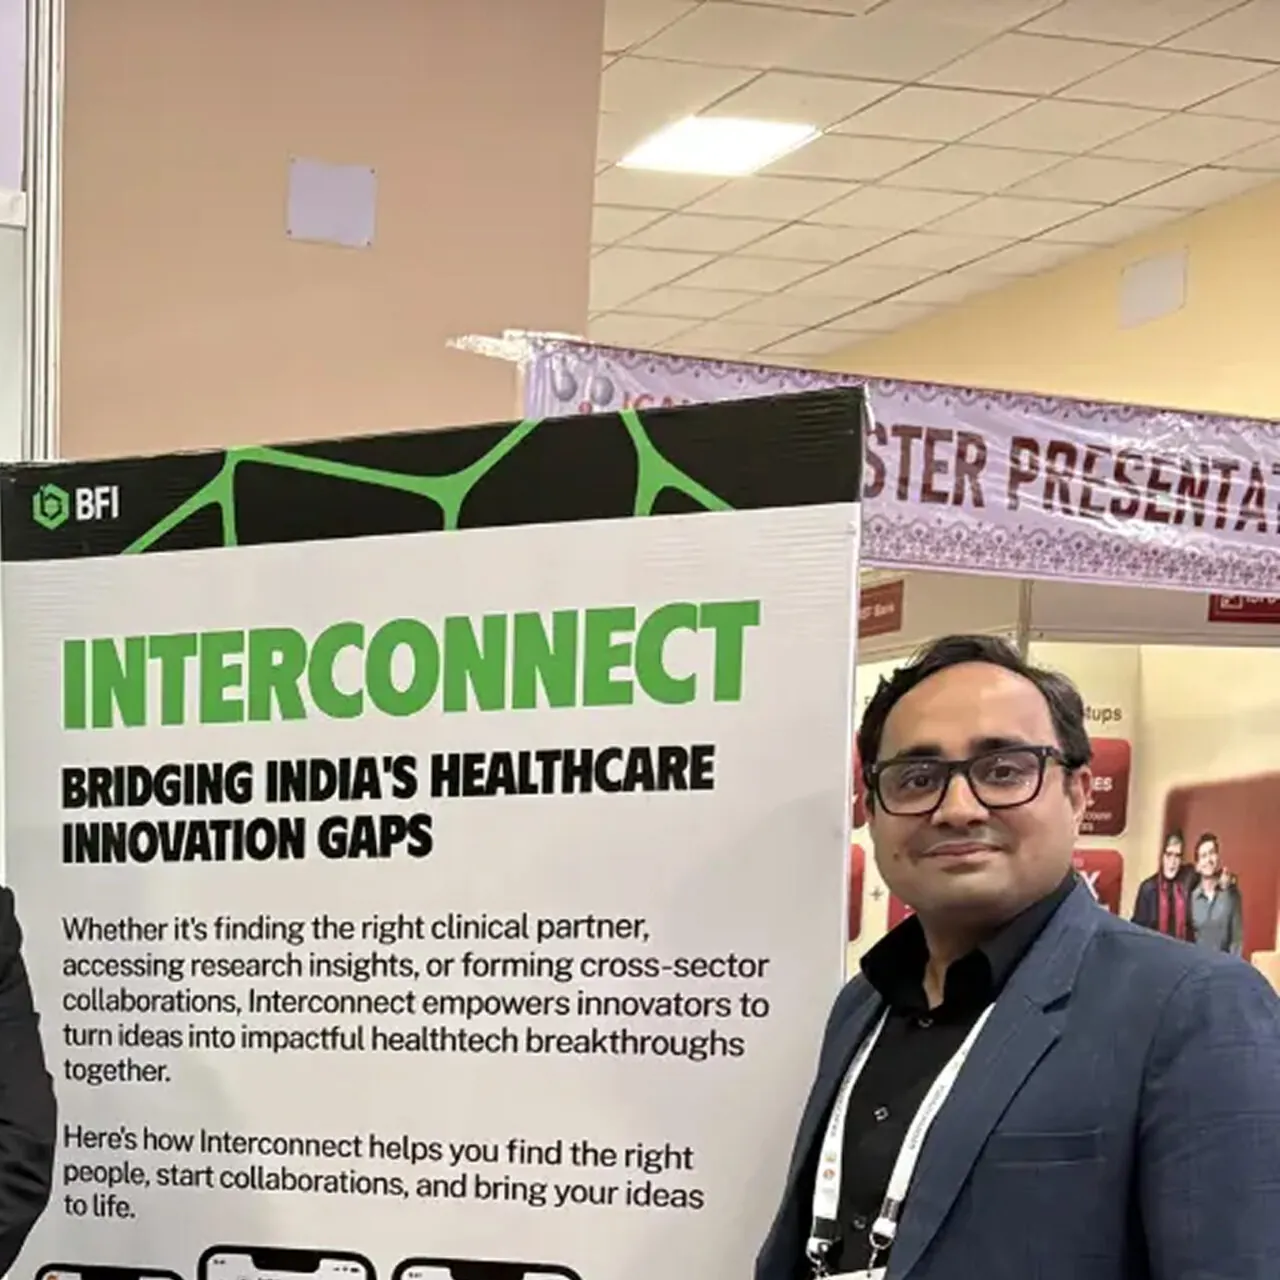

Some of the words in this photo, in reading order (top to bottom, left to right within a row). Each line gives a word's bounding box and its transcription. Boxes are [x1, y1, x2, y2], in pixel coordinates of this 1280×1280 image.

[76, 486, 118, 520] BFI
[64, 602, 760, 729] INTERCONNECT
[63, 761, 252, 808] BRIDGING
[267, 755, 417, 802] INDIA'S
[431, 745, 715, 797] HEALTHCARE
[63, 818, 305, 863] INNOVATION
[318, 813, 432, 859] GAPS
[62, 917, 168, 941] Whether
[175, 917, 207, 941] it's
[214, 915, 305, 946] finding
[312, 915, 354, 939] the
[362, 914, 424, 944] right
[431, 913, 529, 939] clinical
[537, 915, 649, 943] partner,
[63, 953, 185, 982] accessing
[192, 952, 302, 977] research
[310, 952, 419, 982] insights,
[426, 958, 455, 977] or
[462, 952, 573, 982] forming
[581, 954, 770, 978] cross-sector
[63, 987, 241, 1015] collaborations,
[250, 988, 415, 1014] Interconnect
[422, 995, 570, 1020] empowers
[578, 990, 731, 1017] innovators
[740, 993, 769, 1017] to
[63, 1024, 112, 1046] turn
[119, 1023, 183, 1048] ideas
[189, 1024, 235, 1048] into
[242, 1025, 364, 1053] impactful
[372, 1026, 518, 1053] healthtech
[526, 1027, 744, 1061] breakthroughs
[64, 1058, 170, 1085] together.
[64, 1124, 137, 1150] Here's
[144, 1127, 194, 1152] how
[201, 1129, 362, 1157] Interconnect
[370, 1134, 443, 1165] helps
[450, 1144, 498, 1166] you
[507, 1139, 562, 1165] find
[570, 1140, 617, 1166] the
[625, 1143, 693, 1174] right
[64, 1161, 150, 1188] people,
[156, 1165, 214, 1188] start
[220, 1165, 408, 1198] collaborations,
[416, 1173, 466, 1198] and
[475, 1174, 547, 1206] bring
[554, 1185, 619, 1207] your
[626, 1181, 704, 1209] ideas
[64, 1195, 87, 1216] to
[94, 1194, 135, 1218] life.
